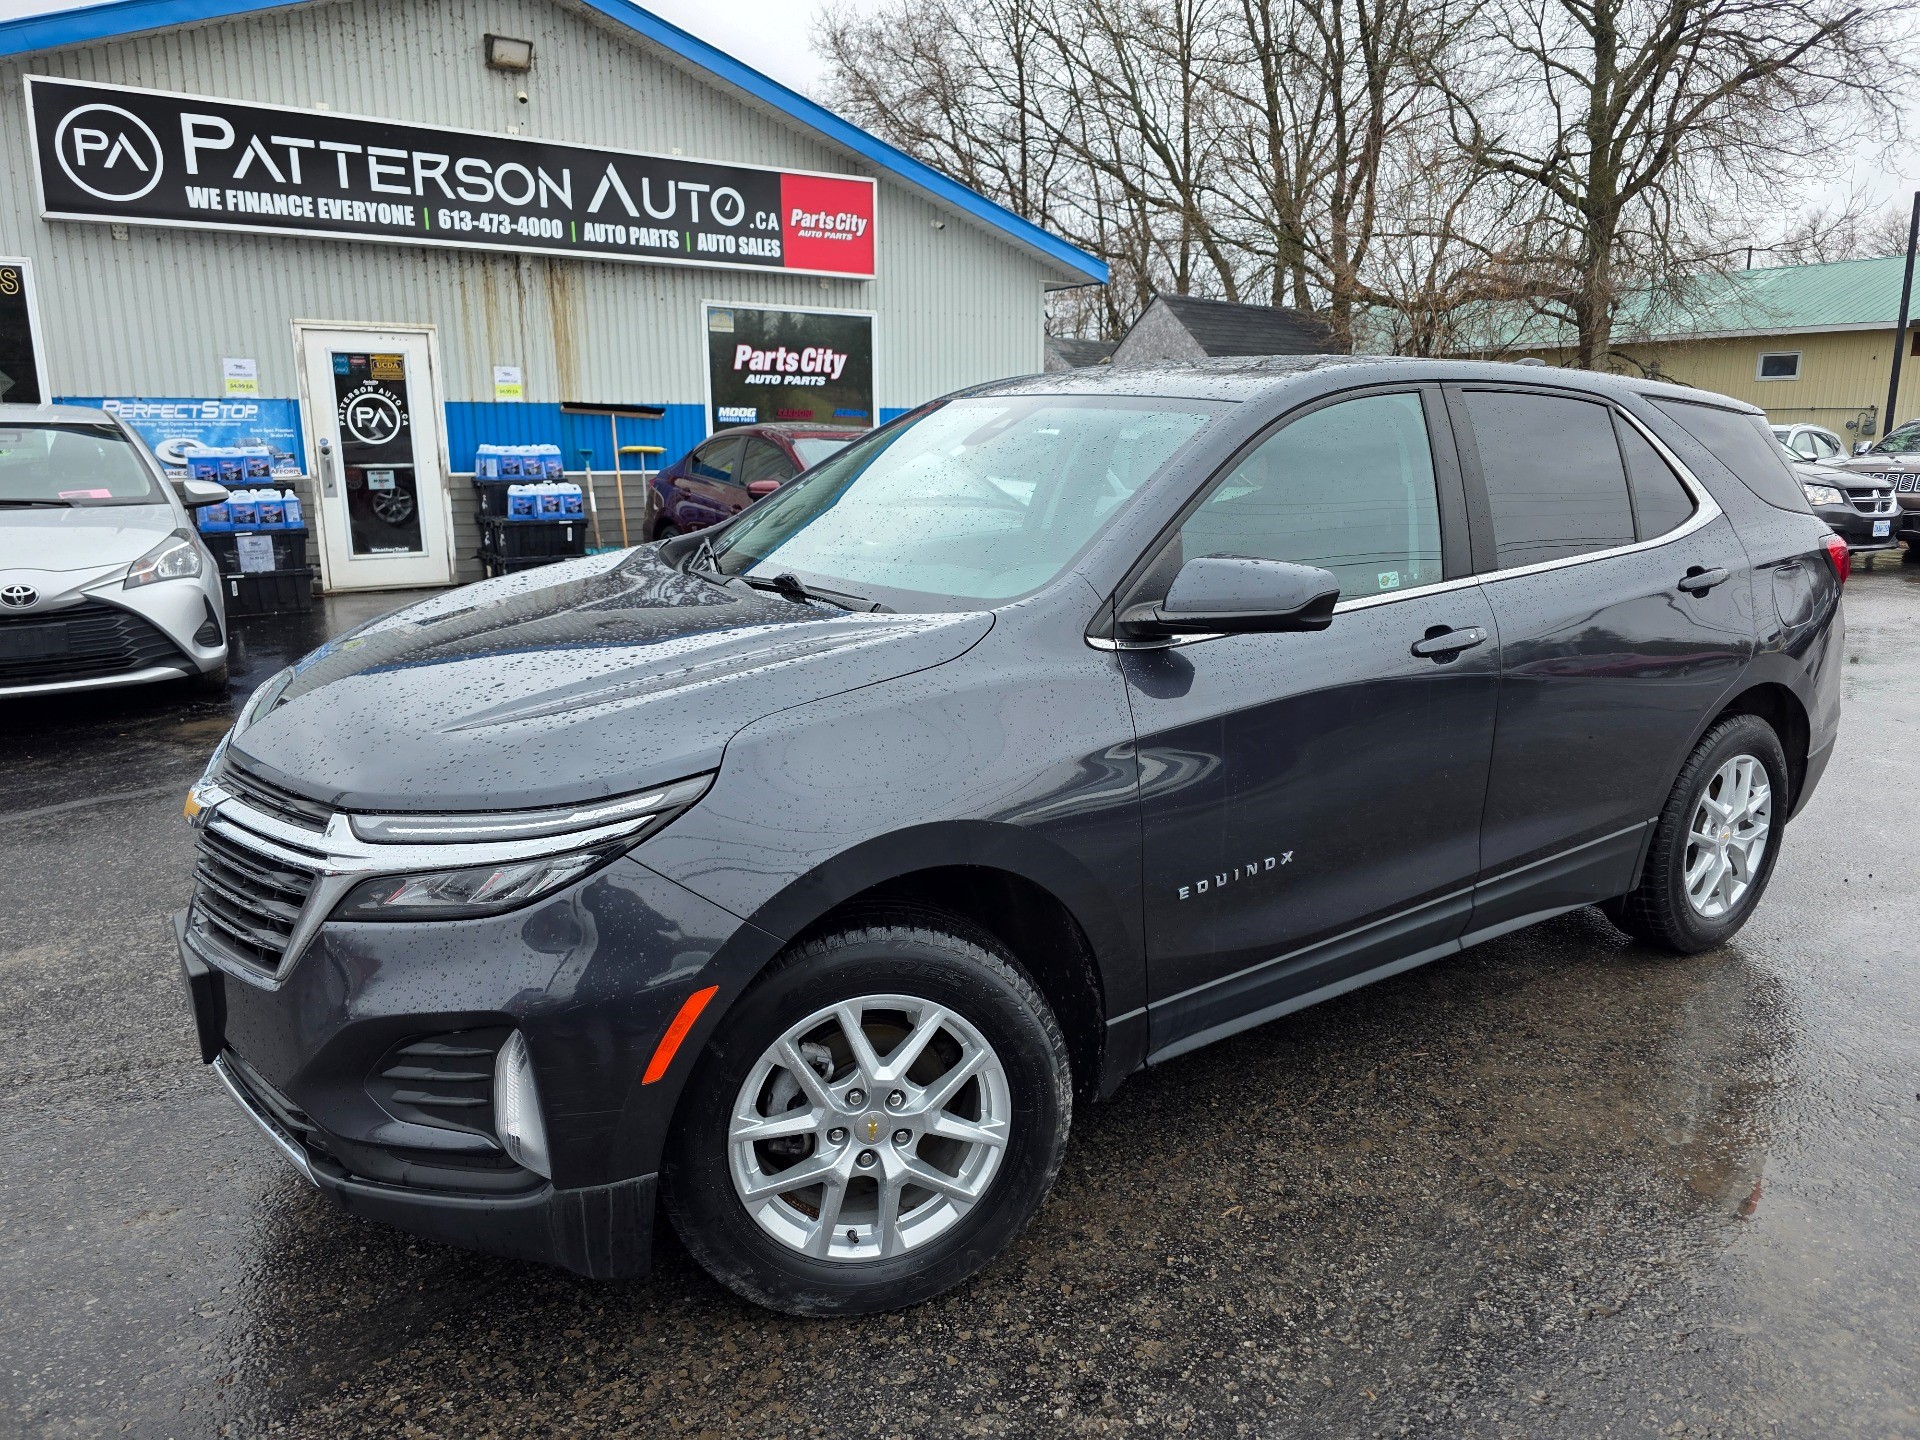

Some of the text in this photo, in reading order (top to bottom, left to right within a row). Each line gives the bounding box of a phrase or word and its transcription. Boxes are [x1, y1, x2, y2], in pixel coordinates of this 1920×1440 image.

[73, 127, 149, 172] PA
[180, 113, 573, 210] PATTERSON
[587, 162, 746, 226] AUTO
[185, 186, 416, 227] WE FINANCE EVERYONE
[438, 208, 563, 239] 613-473-4000
[584, 222, 679, 249] AUTO PARTS
[798, 229, 853, 241] AUTO PARTS
[697, 233, 781, 258] AUTO SALES
[376, 360, 399, 369] UCDA
[745, 374, 826, 386] AUTO PARTS
[339, 386, 374, 427] PATTERSON
[378, 387, 402, 407] AUTO
[356, 406, 394, 428] PA
[718, 407, 757, 417] MOOG
[1178, 851, 1294, 900] EQUINOX
